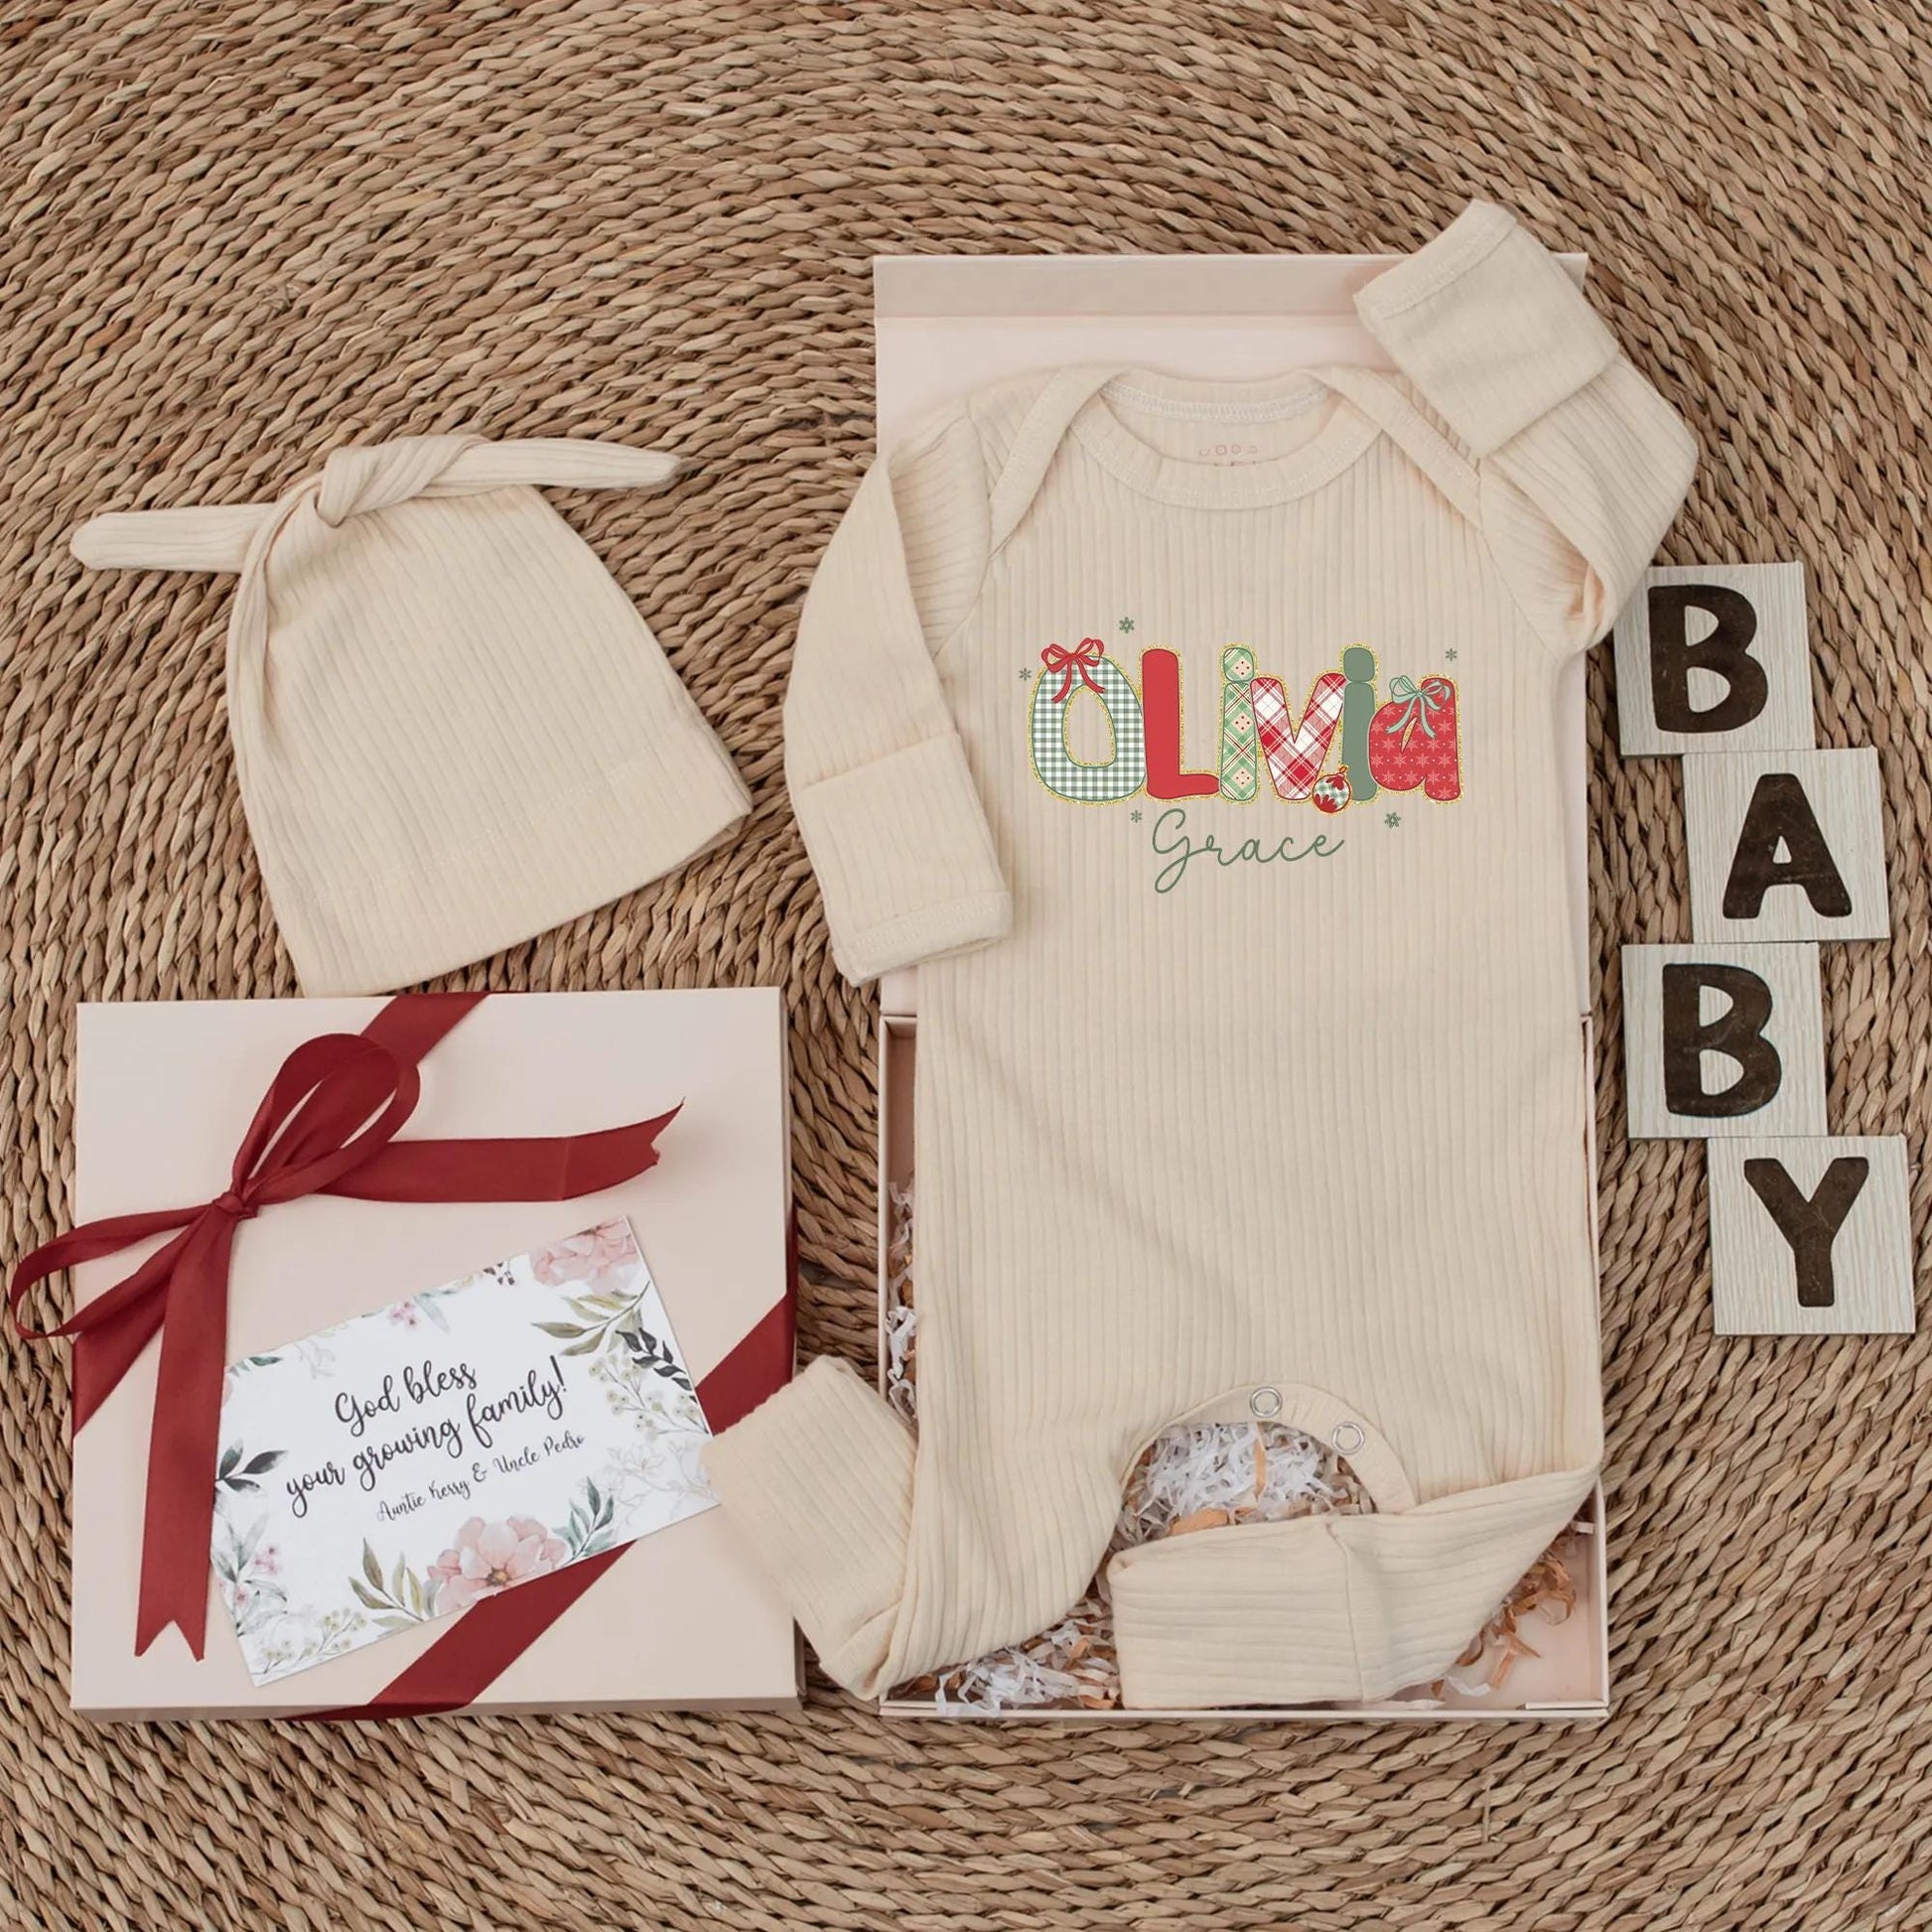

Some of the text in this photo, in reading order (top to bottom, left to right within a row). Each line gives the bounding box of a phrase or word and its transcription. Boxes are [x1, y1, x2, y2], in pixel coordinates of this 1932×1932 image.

[1152, 808, 1345, 894] Grace
[1647, 584, 1869, 1308] BABY
[286, 1355, 567, 1519] your growing family!
[335, 1360, 478, 1437] God bless
[376, 1430, 586, 1522] Auntie Kerry & Uncle Pedro
